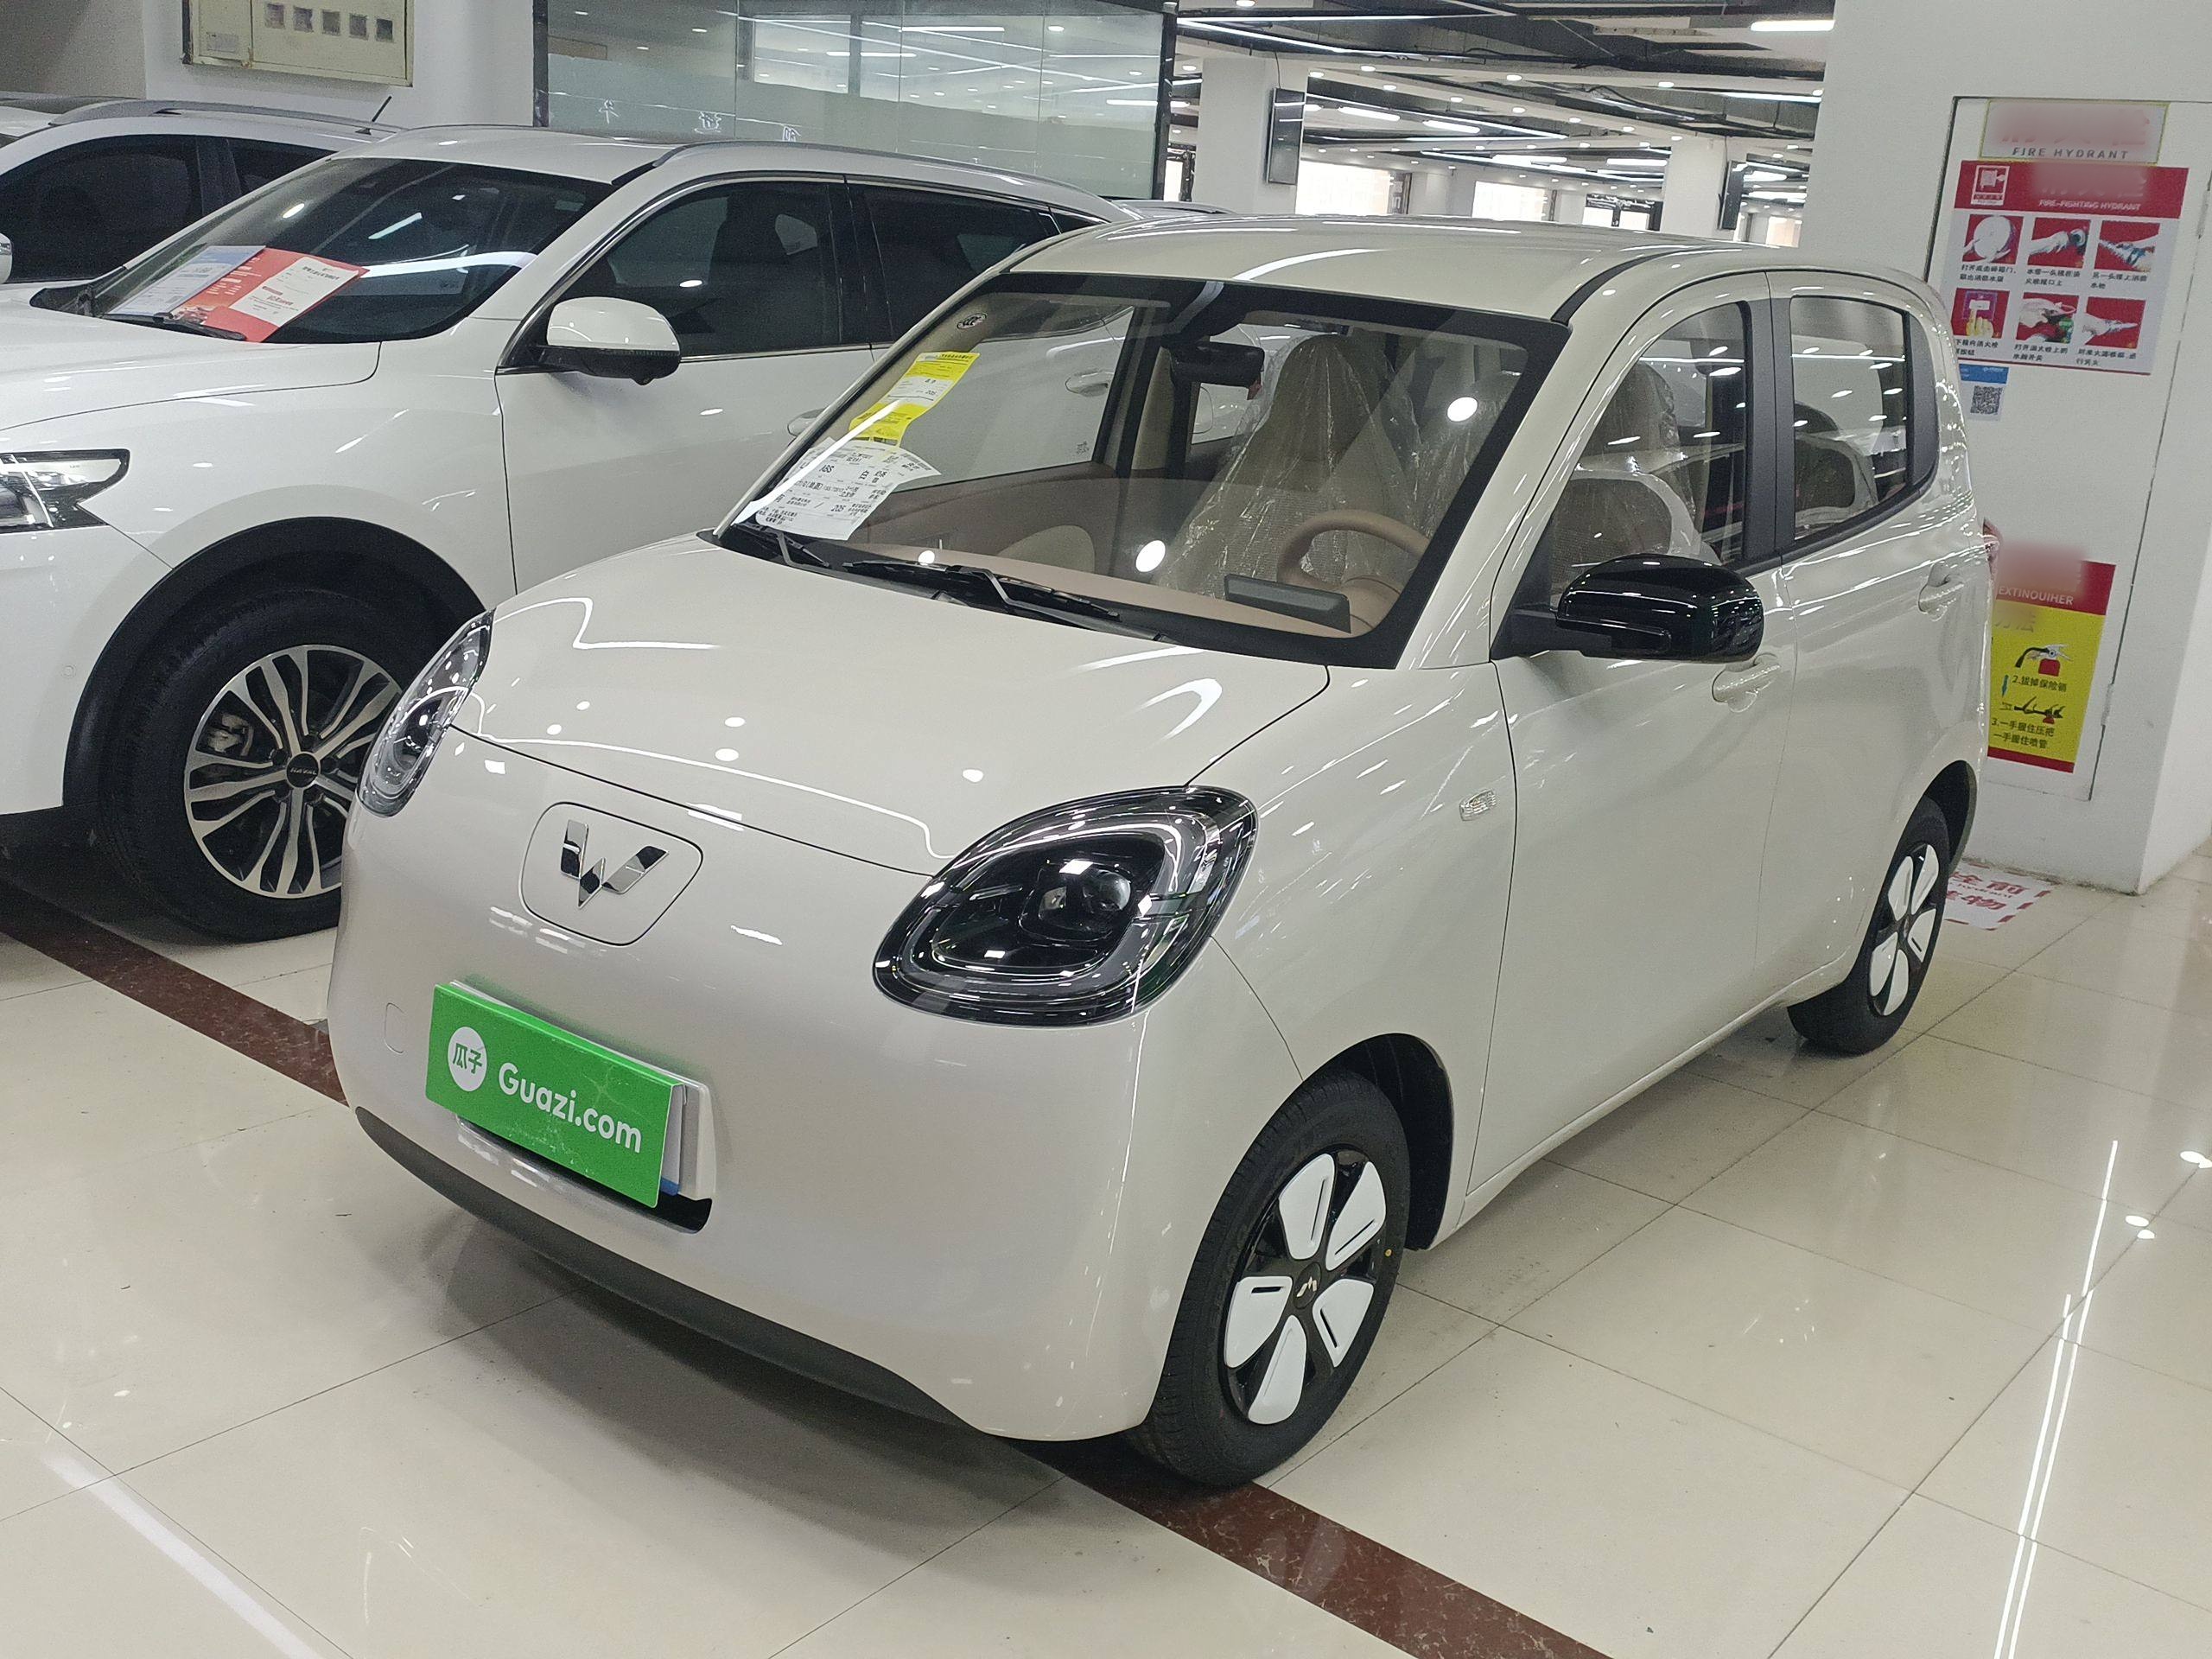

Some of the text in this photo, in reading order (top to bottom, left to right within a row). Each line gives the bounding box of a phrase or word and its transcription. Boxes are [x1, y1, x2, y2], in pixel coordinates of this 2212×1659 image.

[2012, 147, 2129, 160] FIRE HYDRANT
[453, 1042, 483, 1074] 瓜子
[498, 1062, 642, 1154] Guazi.com
